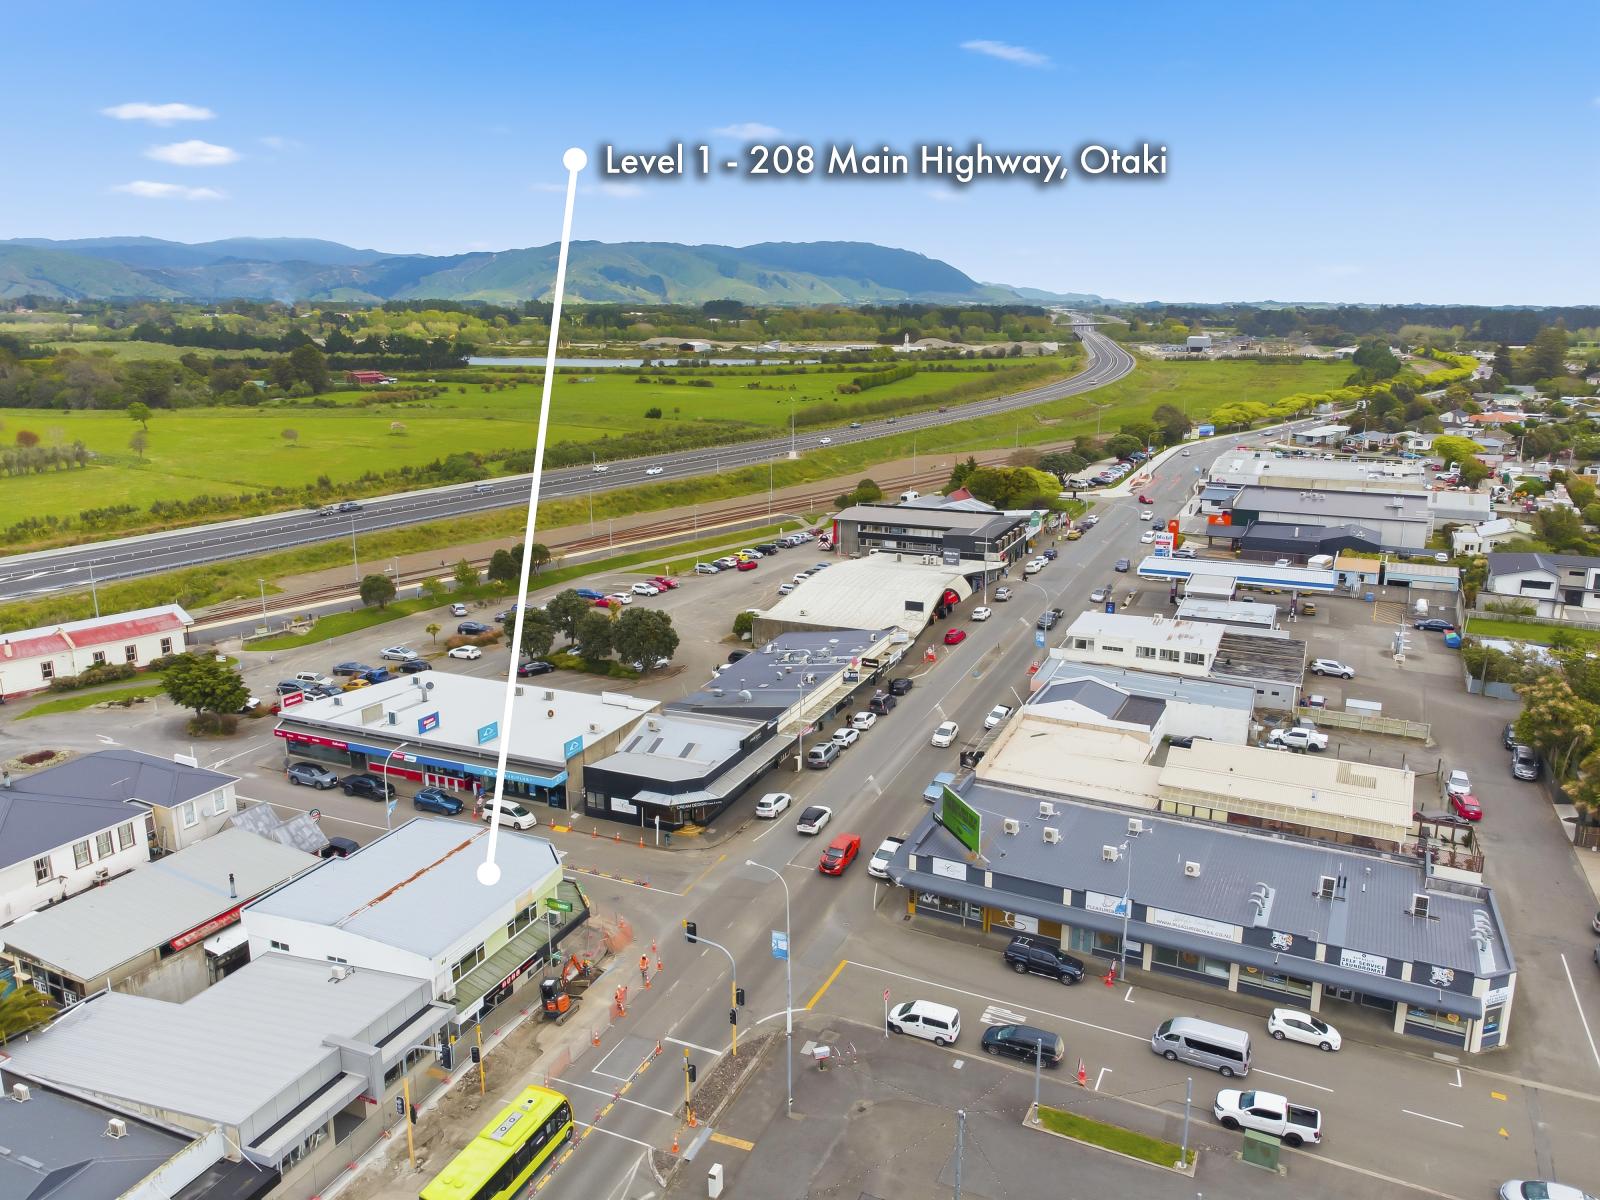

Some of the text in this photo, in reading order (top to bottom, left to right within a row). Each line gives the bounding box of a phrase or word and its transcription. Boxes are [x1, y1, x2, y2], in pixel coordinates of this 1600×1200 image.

[1341, 962, 1386, 975] LAUNDROMAT
[1342, 957, 1361, 966] SELF
[1362, 961, 1386, 971] SERVICE
